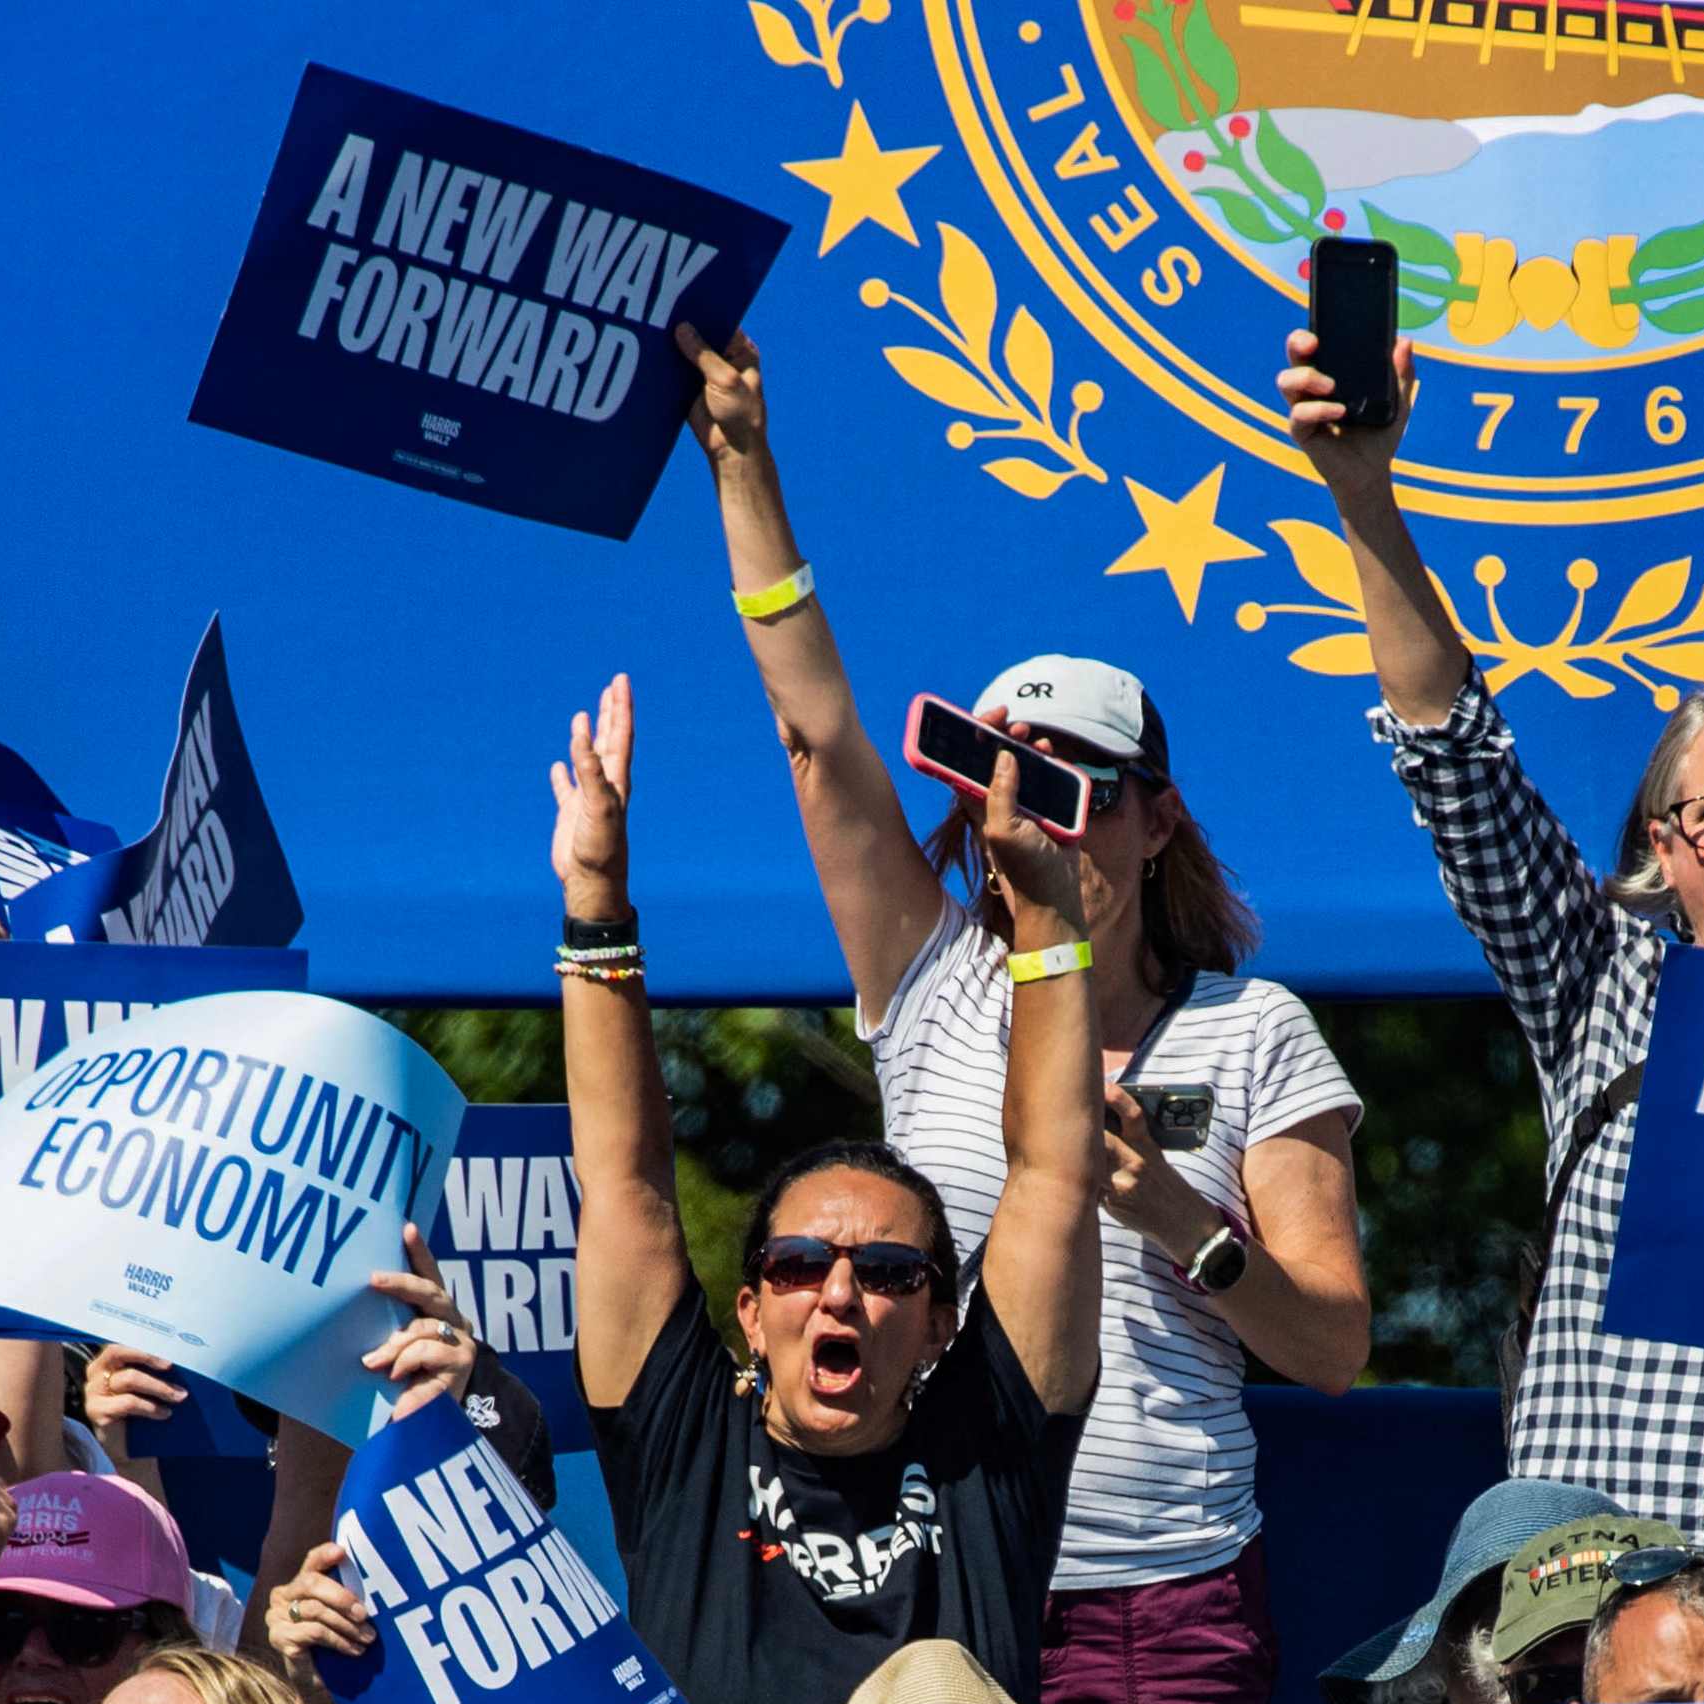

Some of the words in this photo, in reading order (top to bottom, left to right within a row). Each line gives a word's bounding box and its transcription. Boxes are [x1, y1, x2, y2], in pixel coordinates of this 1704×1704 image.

[1028, 63, 1202, 306] SEAL
[307, 133, 375, 236] A
[372, 150, 552, 282] NEW
[542, 200, 718, 329] WAY
[298, 242, 640, 422] FORWARD
[421, 413, 461, 439] HARRIS
[1473, 385, 1687, 454] 776
[1017, 681, 1054, 699] OR
[26, 1046, 434, 1220] OPPORTUNITY
[19, 1116, 370, 1287] ECONOMY
[445, 1157, 577, 1251] WA
[124, 1263, 174, 1292] HARRIS
[127, 1280, 160, 1299] WALZ
[18, 1492, 85, 1515] MALA
[17, 1511, 80, 1532] RRIS
[335, 1509, 405, 1618] A
[382, 1436, 547, 1591] NEW
[1529, 1563, 1614, 1597] VETER
[612, 1654, 642, 1686] HARRIS
[624, 1672, 645, 1692] WALZ
